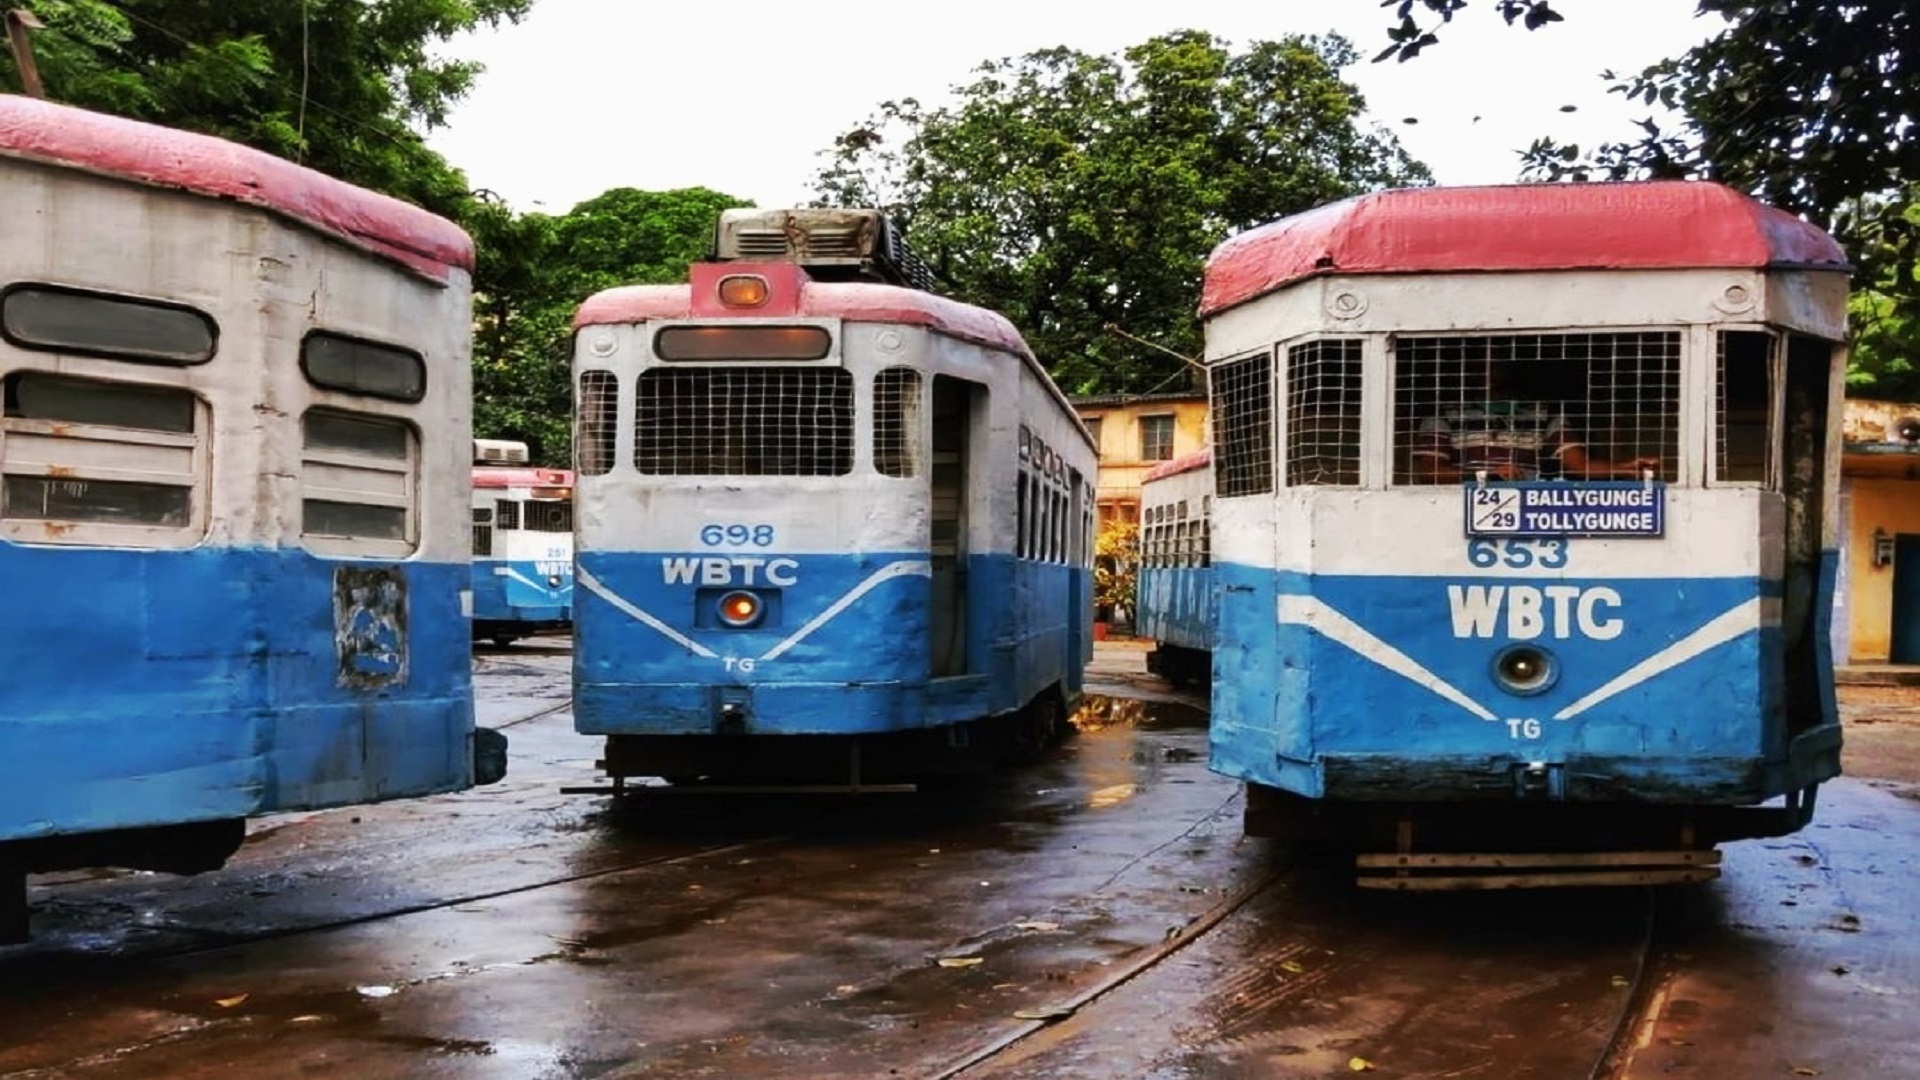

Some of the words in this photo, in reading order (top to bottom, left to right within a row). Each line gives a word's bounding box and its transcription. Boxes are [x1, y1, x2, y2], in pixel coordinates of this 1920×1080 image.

[1526, 490, 1653, 506] BALLYGUNGE
[1525, 512, 1653, 530] TOLLYGUNGE
[701, 525, 773, 546] 698
[1467, 537, 1569, 569] 653
[662, 557, 799, 585] WBTC
[1447, 585, 1624, 640] WBTC
[723, 657, 755, 672] TG
[1507, 718, 1541, 739] TG
